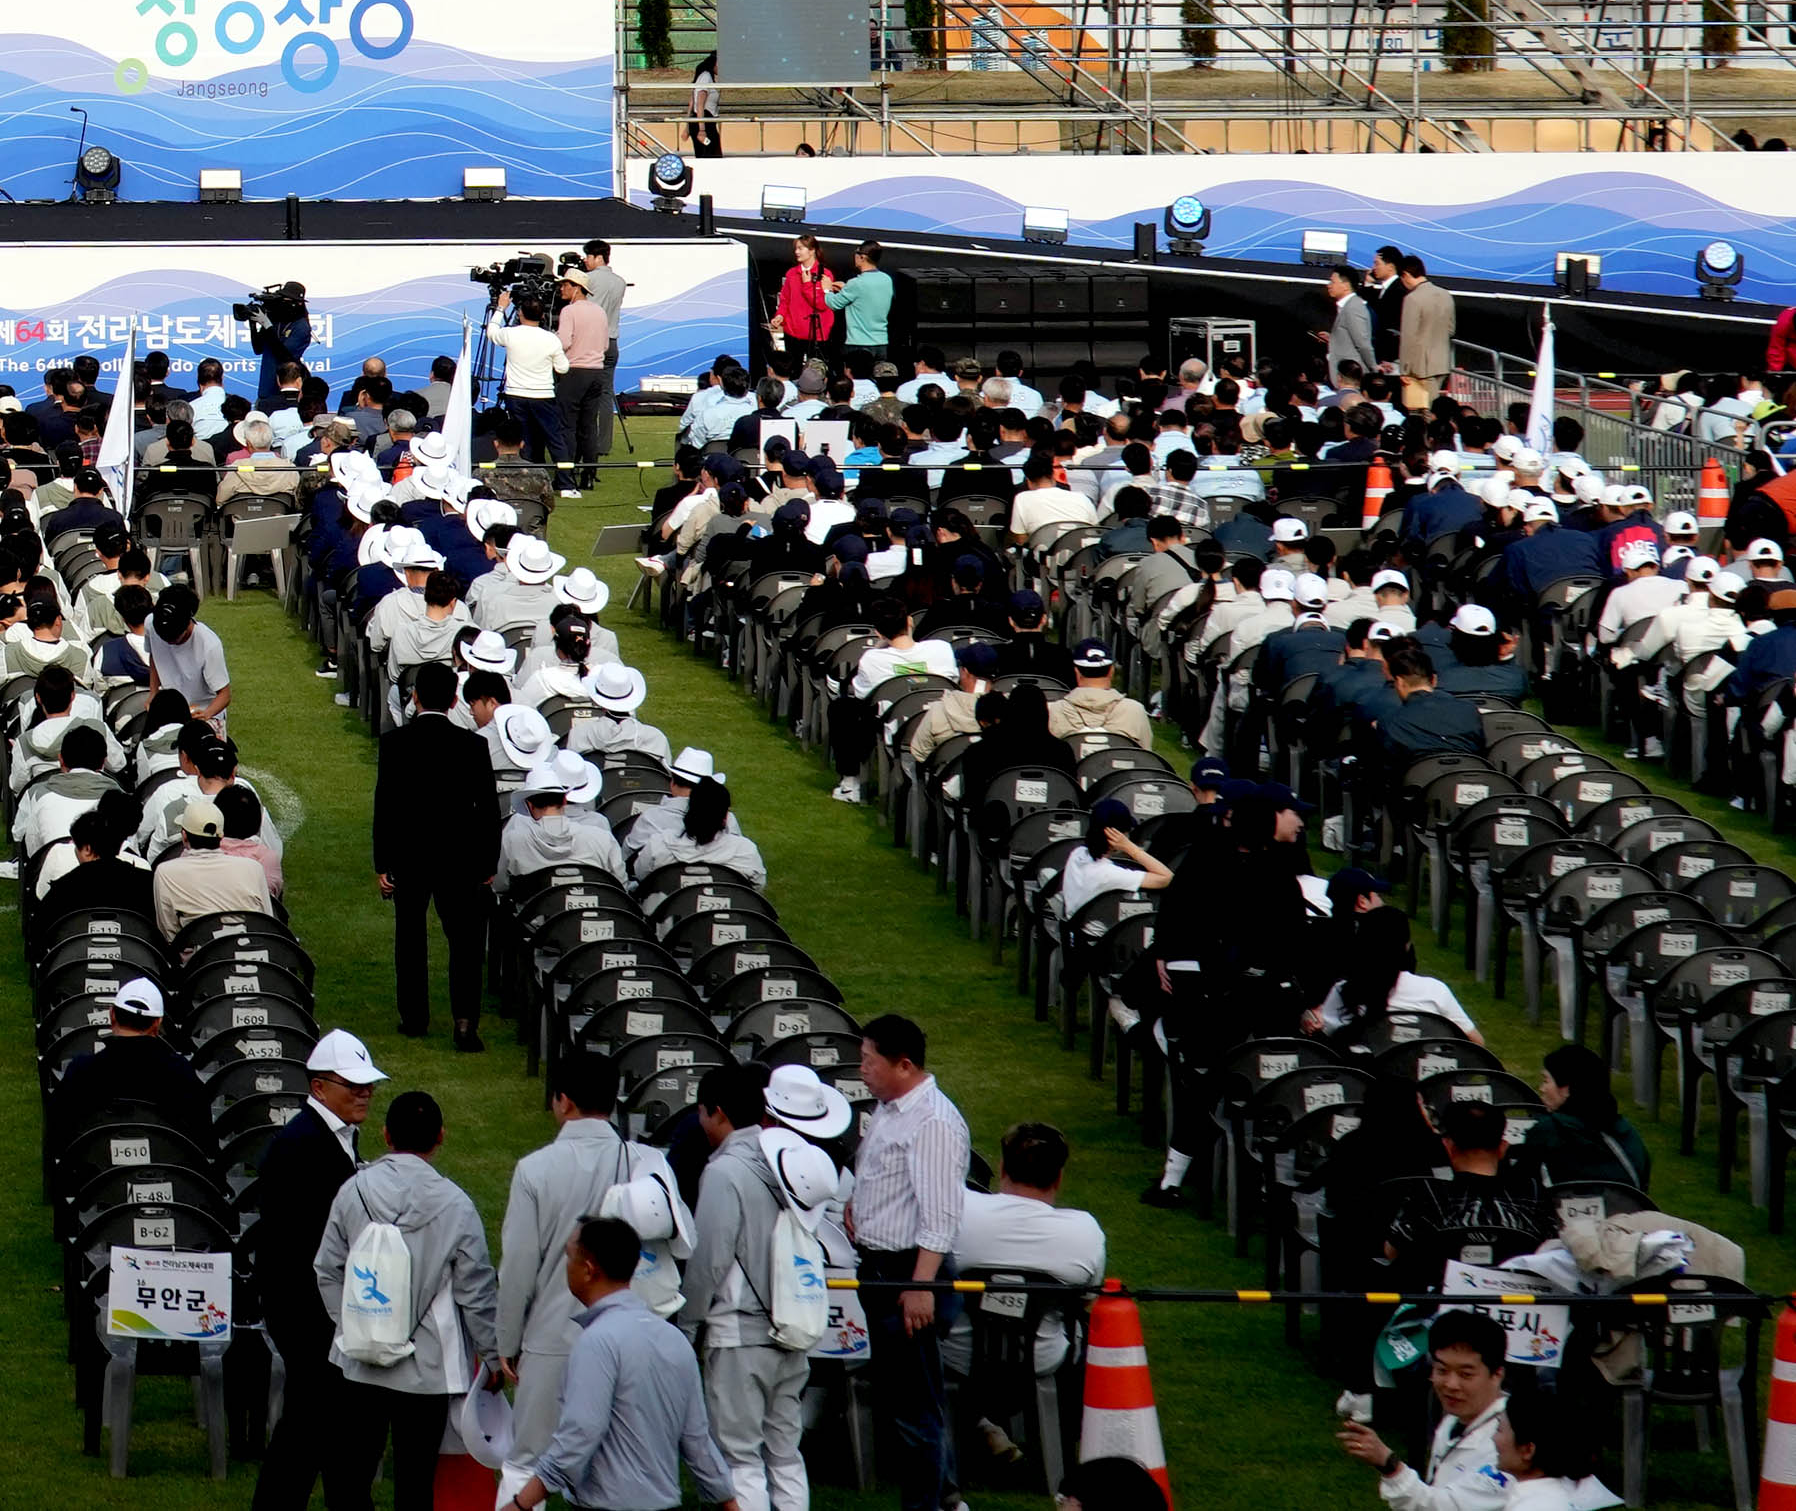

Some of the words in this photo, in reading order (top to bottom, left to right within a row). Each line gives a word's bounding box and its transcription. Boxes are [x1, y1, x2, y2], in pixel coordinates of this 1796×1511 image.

[176, 80, 270, 98] Jangseong
[618, 986, 652, 997] C-205
[767, 986, 792, 996] E-76
[779, 1022, 804, 1034] D-91
[247, 1047, 281, 1058] A-529
[114, 1146, 147, 1158] J-610
[140, 1226, 169, 1239] B-62
[136, 1287, 207, 1311] 무안군
